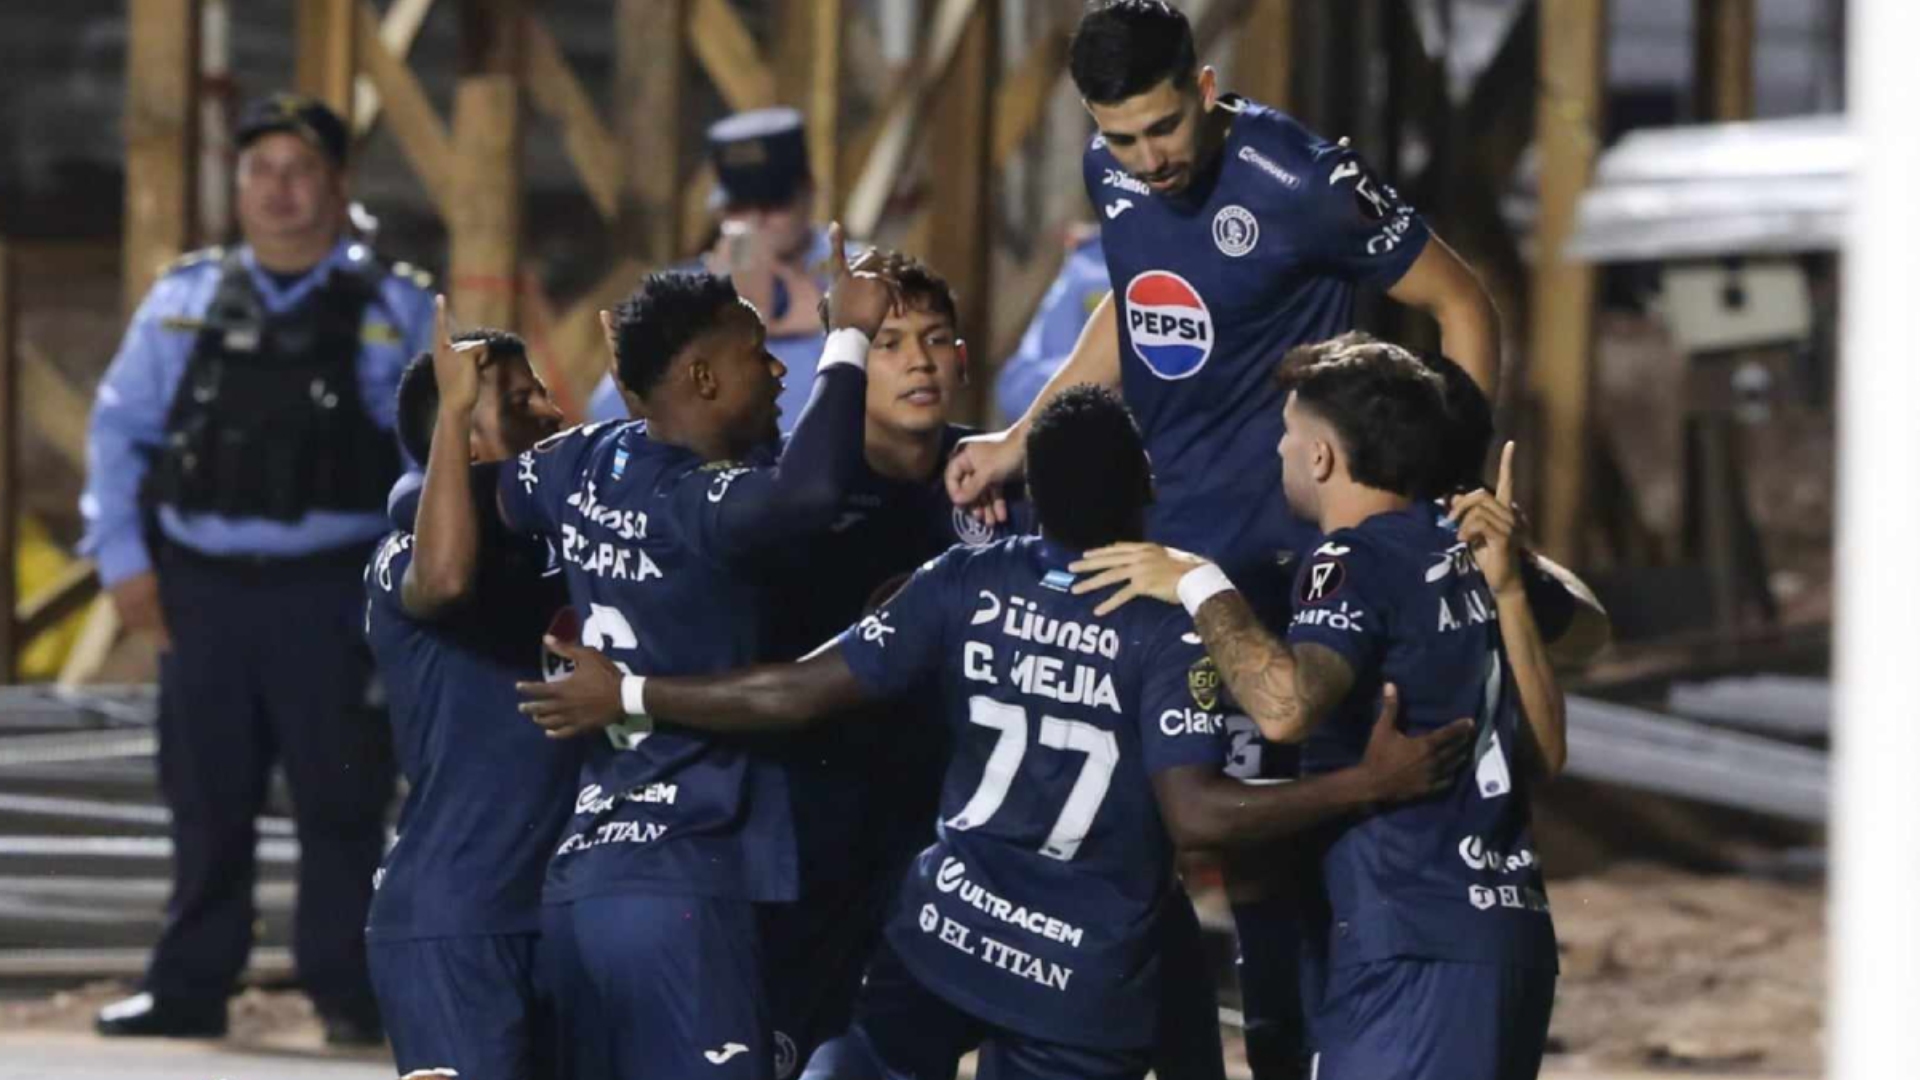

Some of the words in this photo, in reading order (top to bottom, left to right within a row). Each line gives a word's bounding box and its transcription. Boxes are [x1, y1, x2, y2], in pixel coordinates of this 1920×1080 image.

[1130, 309, 1206, 341] PEPSI
[1002, 595, 1120, 661] Diunsa
[1010, 650, 1123, 714] MEJIA
[944, 695, 1120, 861] 77
[959, 879, 1084, 947] ULTRACEM
[938, 916, 975, 955] EL
[980, 936, 1074, 991] TITAN
